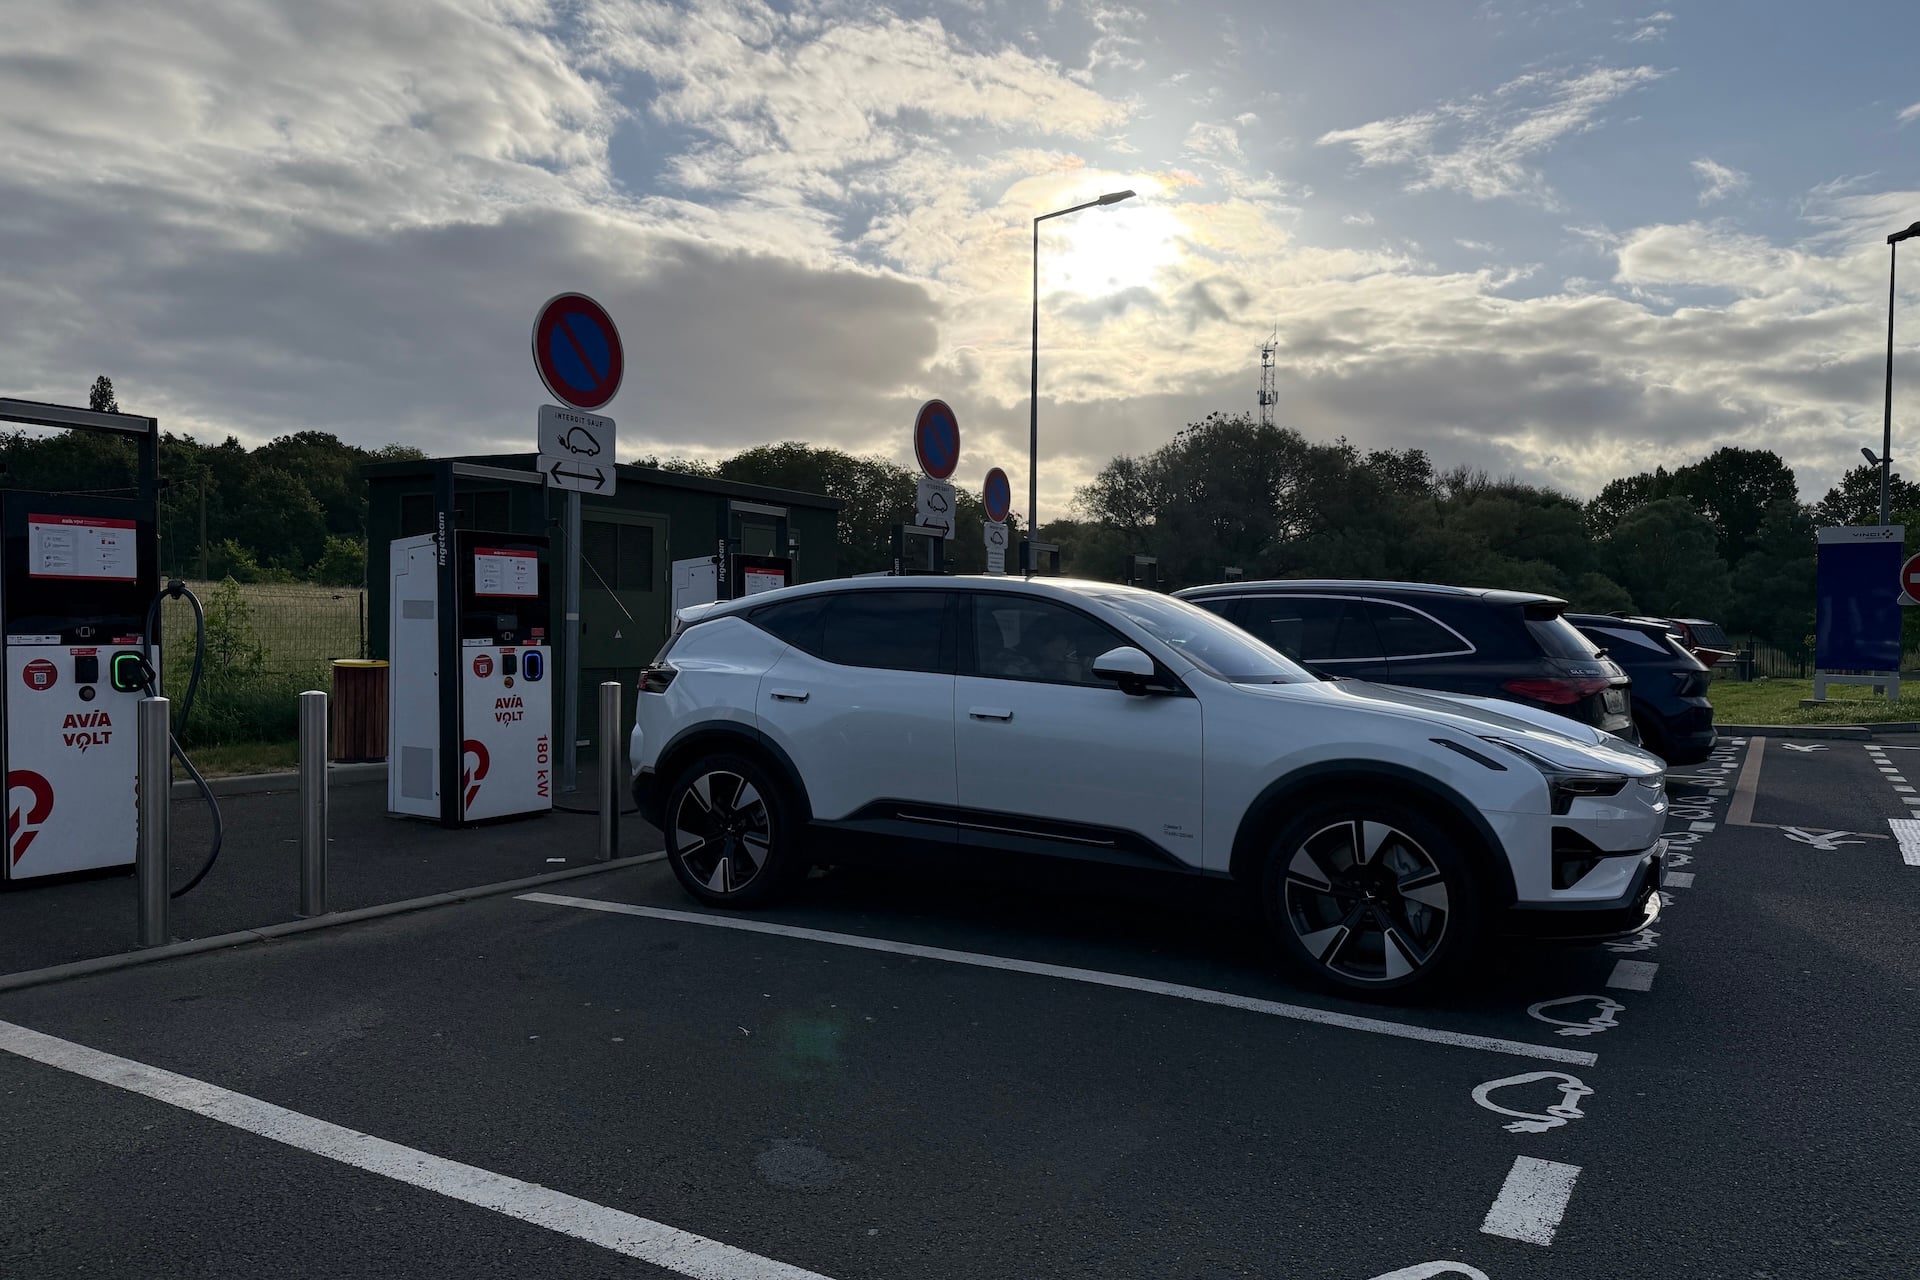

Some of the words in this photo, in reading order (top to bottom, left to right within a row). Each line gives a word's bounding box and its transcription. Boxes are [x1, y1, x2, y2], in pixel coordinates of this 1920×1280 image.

[438, 511, 448, 566] Ingeteam
[495, 711, 523, 728] VOLT
[63, 731, 112, 754] VOLT
[537, 735, 548, 764] 180
[537, 769, 549, 797] kW
